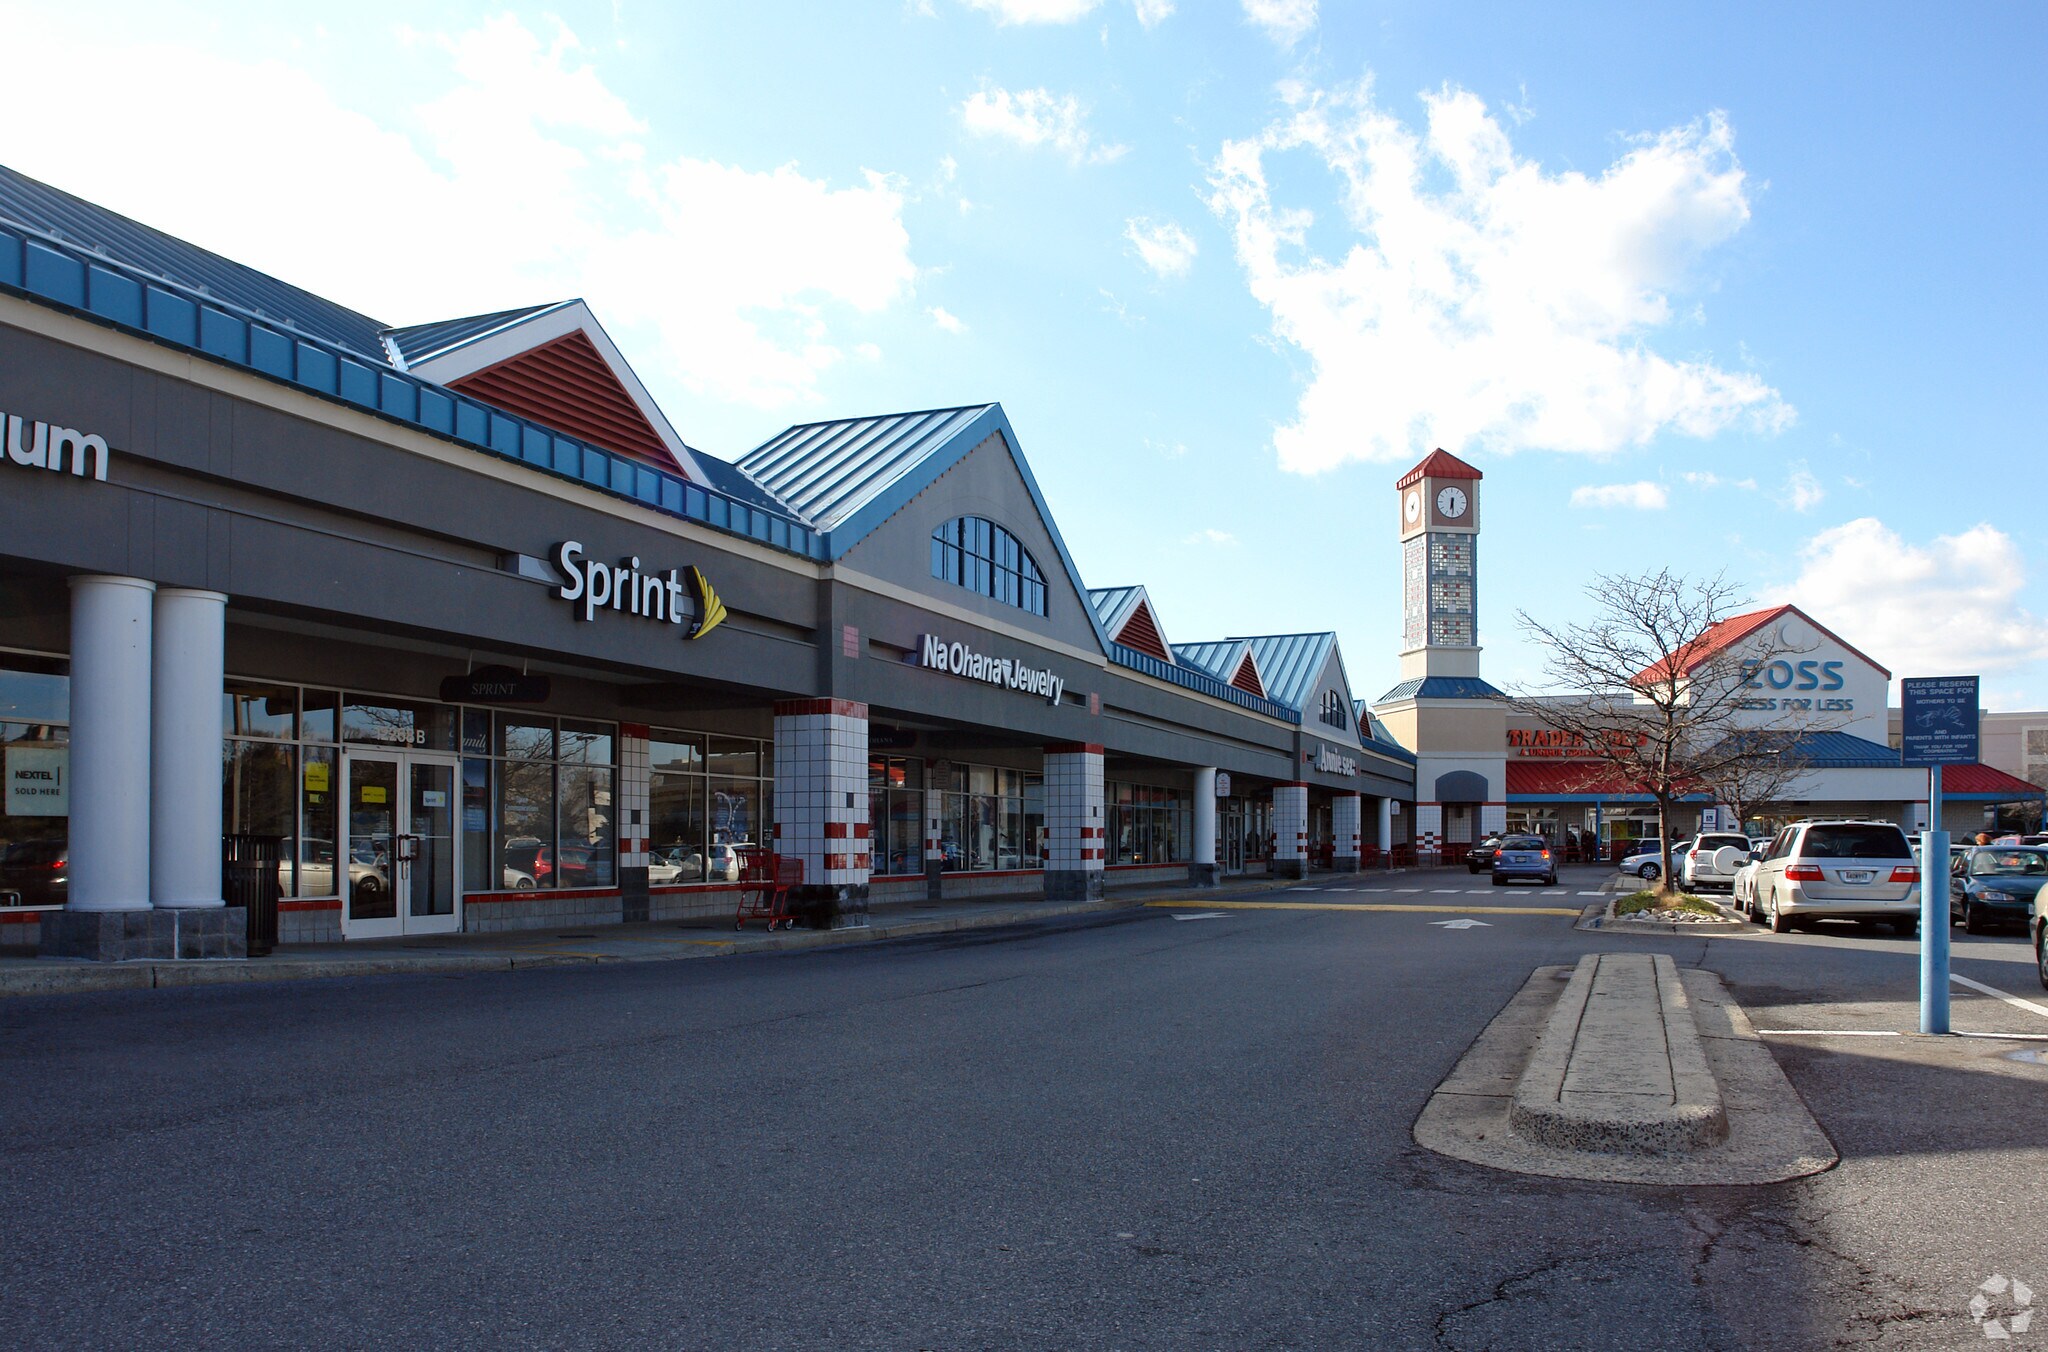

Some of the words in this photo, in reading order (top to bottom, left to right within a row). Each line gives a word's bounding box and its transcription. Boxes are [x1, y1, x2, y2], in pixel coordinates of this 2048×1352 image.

[559, 540, 682, 624] Sprint
[922, 633, 947, 671] Na
[950, 641, 1002, 684] Ohana
[1010, 659, 1064, 706] Jewelry
[471, 683, 517, 695] SPRINT
[1907, 681, 1937, 689] PLEASE
[1939, 680, 1976, 688] RESERVE
[1909, 688, 1927, 696] THIS
[1817, 698, 1854, 711] LESS
[1506, 729, 1584, 747] TRADER
[15, 770, 53, 780] NEXTEL
[15, 787, 37, 795] SOLD
[40, 788, 61, 796] HERE
